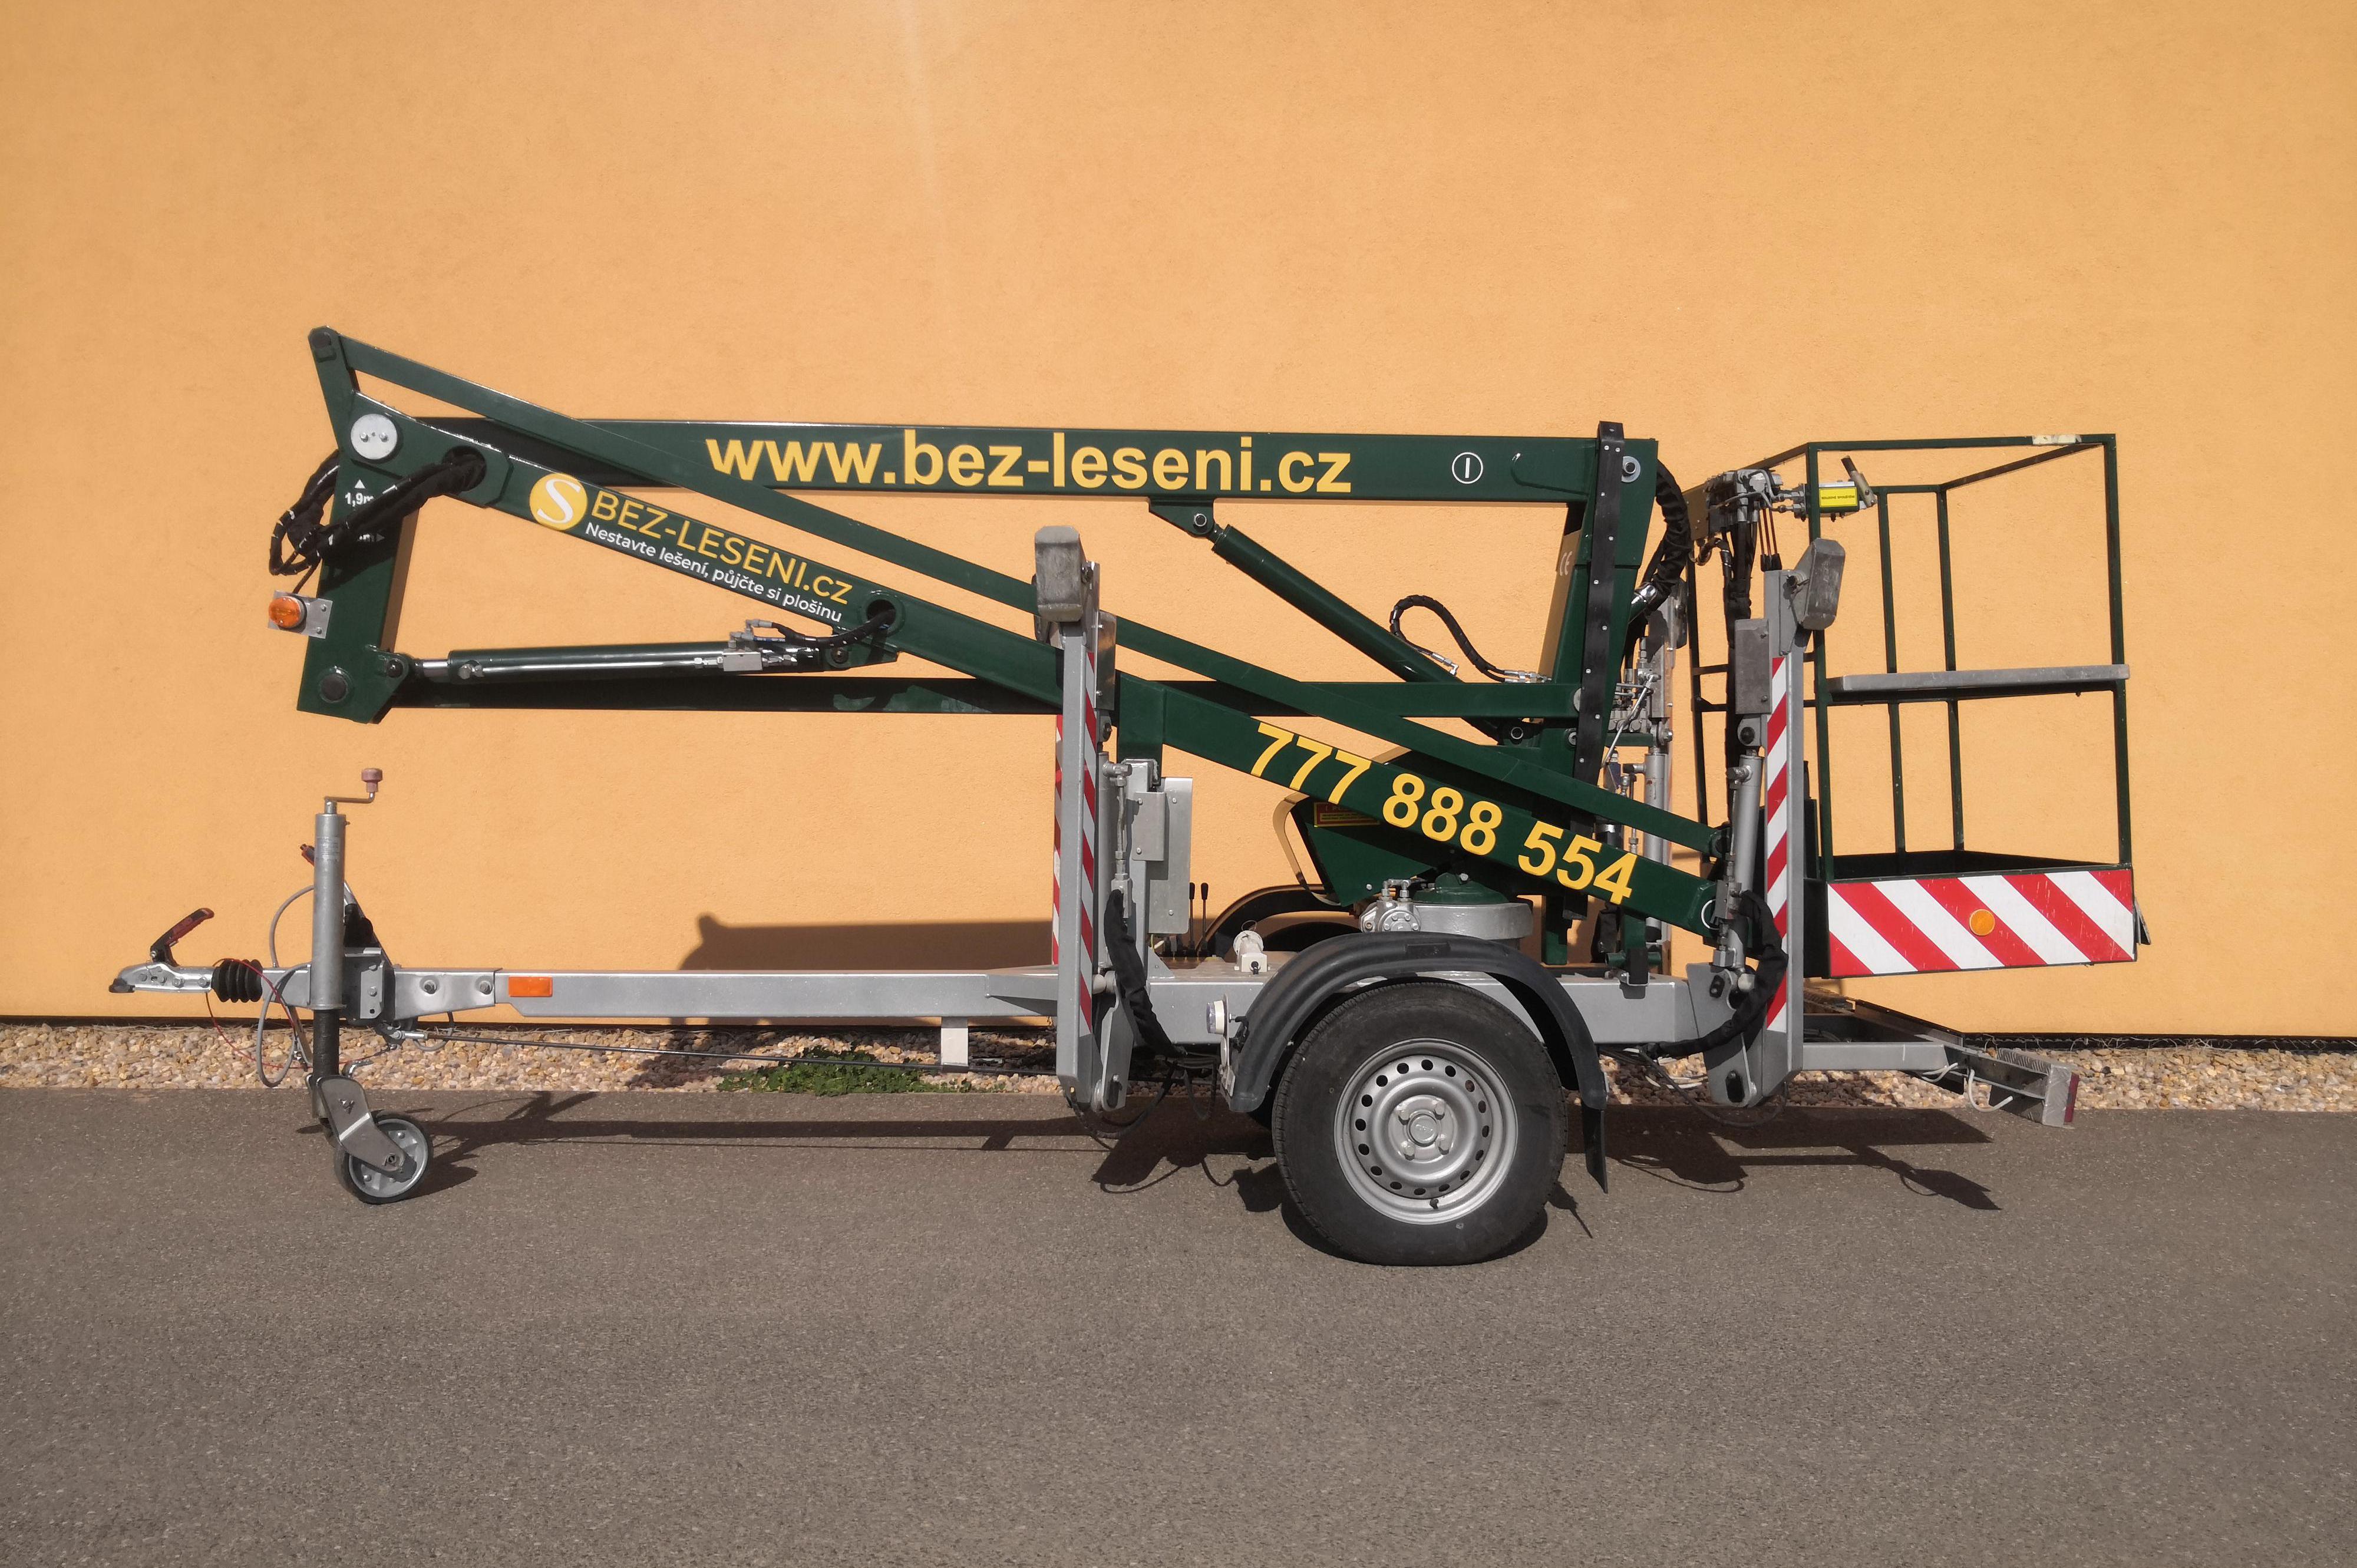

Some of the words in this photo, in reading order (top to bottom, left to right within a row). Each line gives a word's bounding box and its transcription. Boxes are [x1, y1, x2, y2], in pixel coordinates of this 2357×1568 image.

[705, 428, 1351, 491] www.bez-leseni.cz
[585, 521, 656, 557] Nestavte
[659, 547, 709, 578] lešení,
[712, 568, 764, 596] půjčte
[767, 586, 781, 600] si
[783, 593, 842, 622] plošinu
[1250, 722, 1371, 805] 777
[1382, 773, 1503, 856] 888
[1518, 820, 1638, 905] 554
